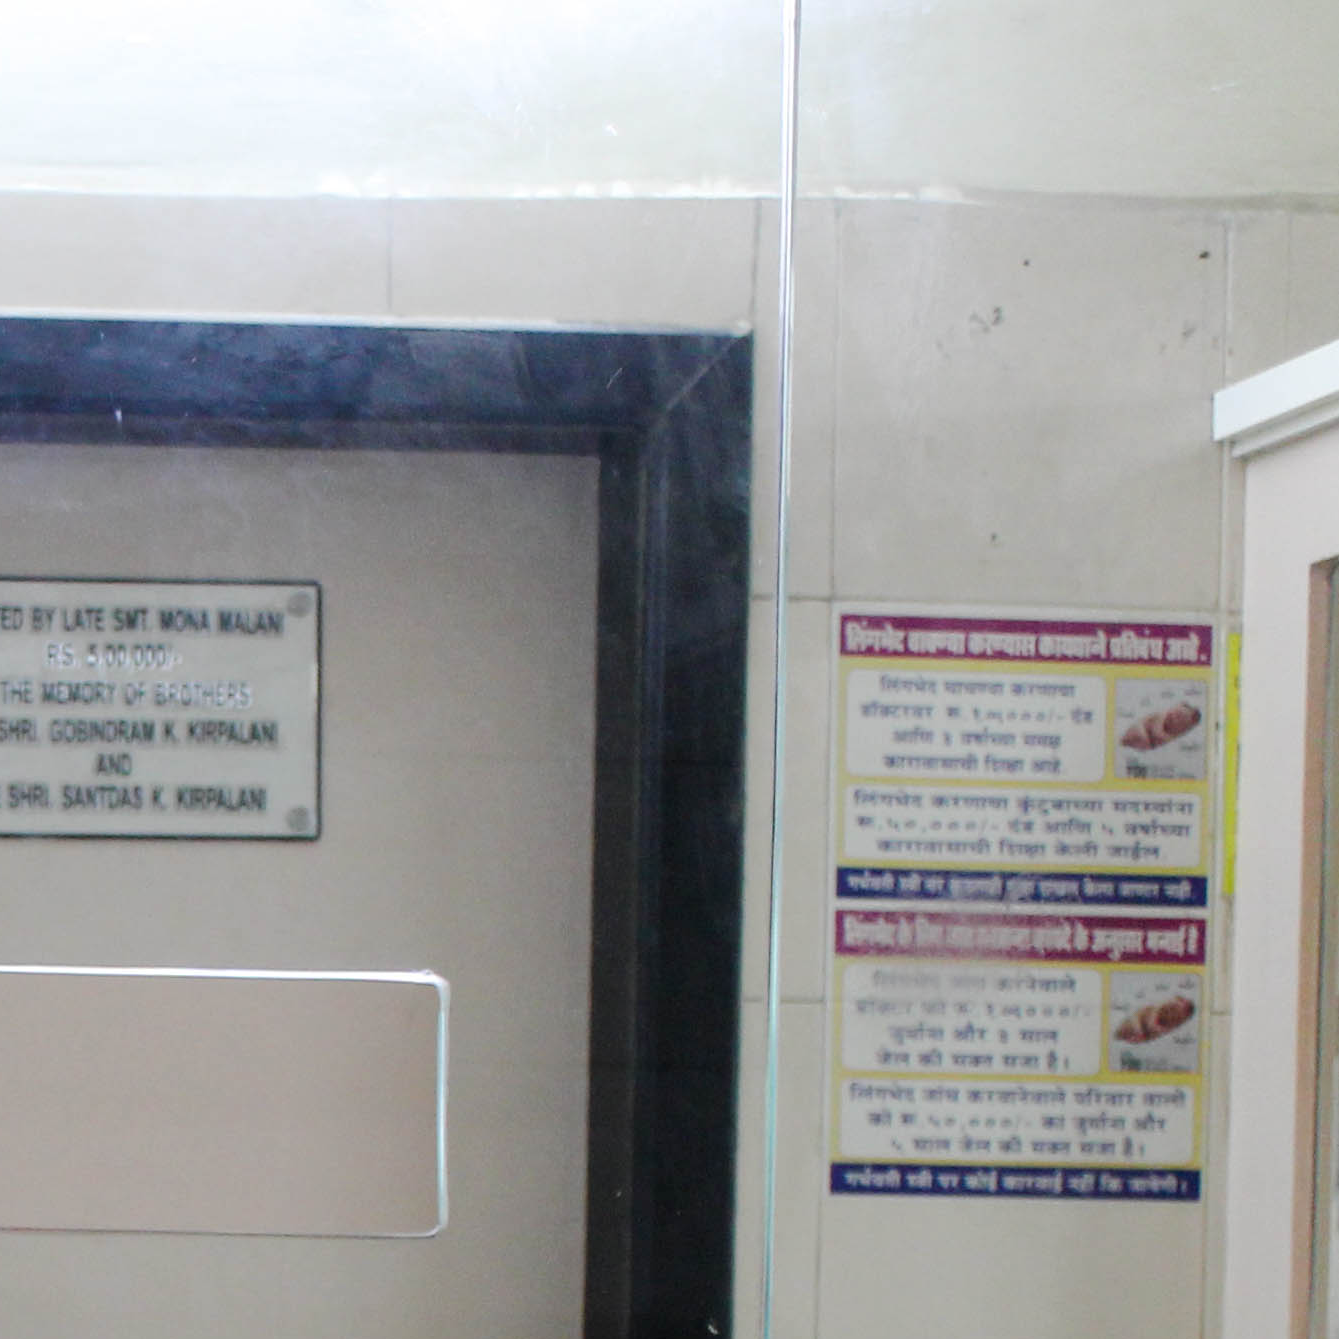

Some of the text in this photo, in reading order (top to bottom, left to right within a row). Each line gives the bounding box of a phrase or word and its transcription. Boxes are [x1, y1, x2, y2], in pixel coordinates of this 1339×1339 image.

[31, 607, 56, 632] BY
[63, 608, 103, 633] LATE
[160, 610, 210, 633] MONA
[1, 681, 32, 704] THE
[42, 682, 116, 706] MEMORY
[126, 683, 147, 706] OF
[95, 753, 131, 777] AND
